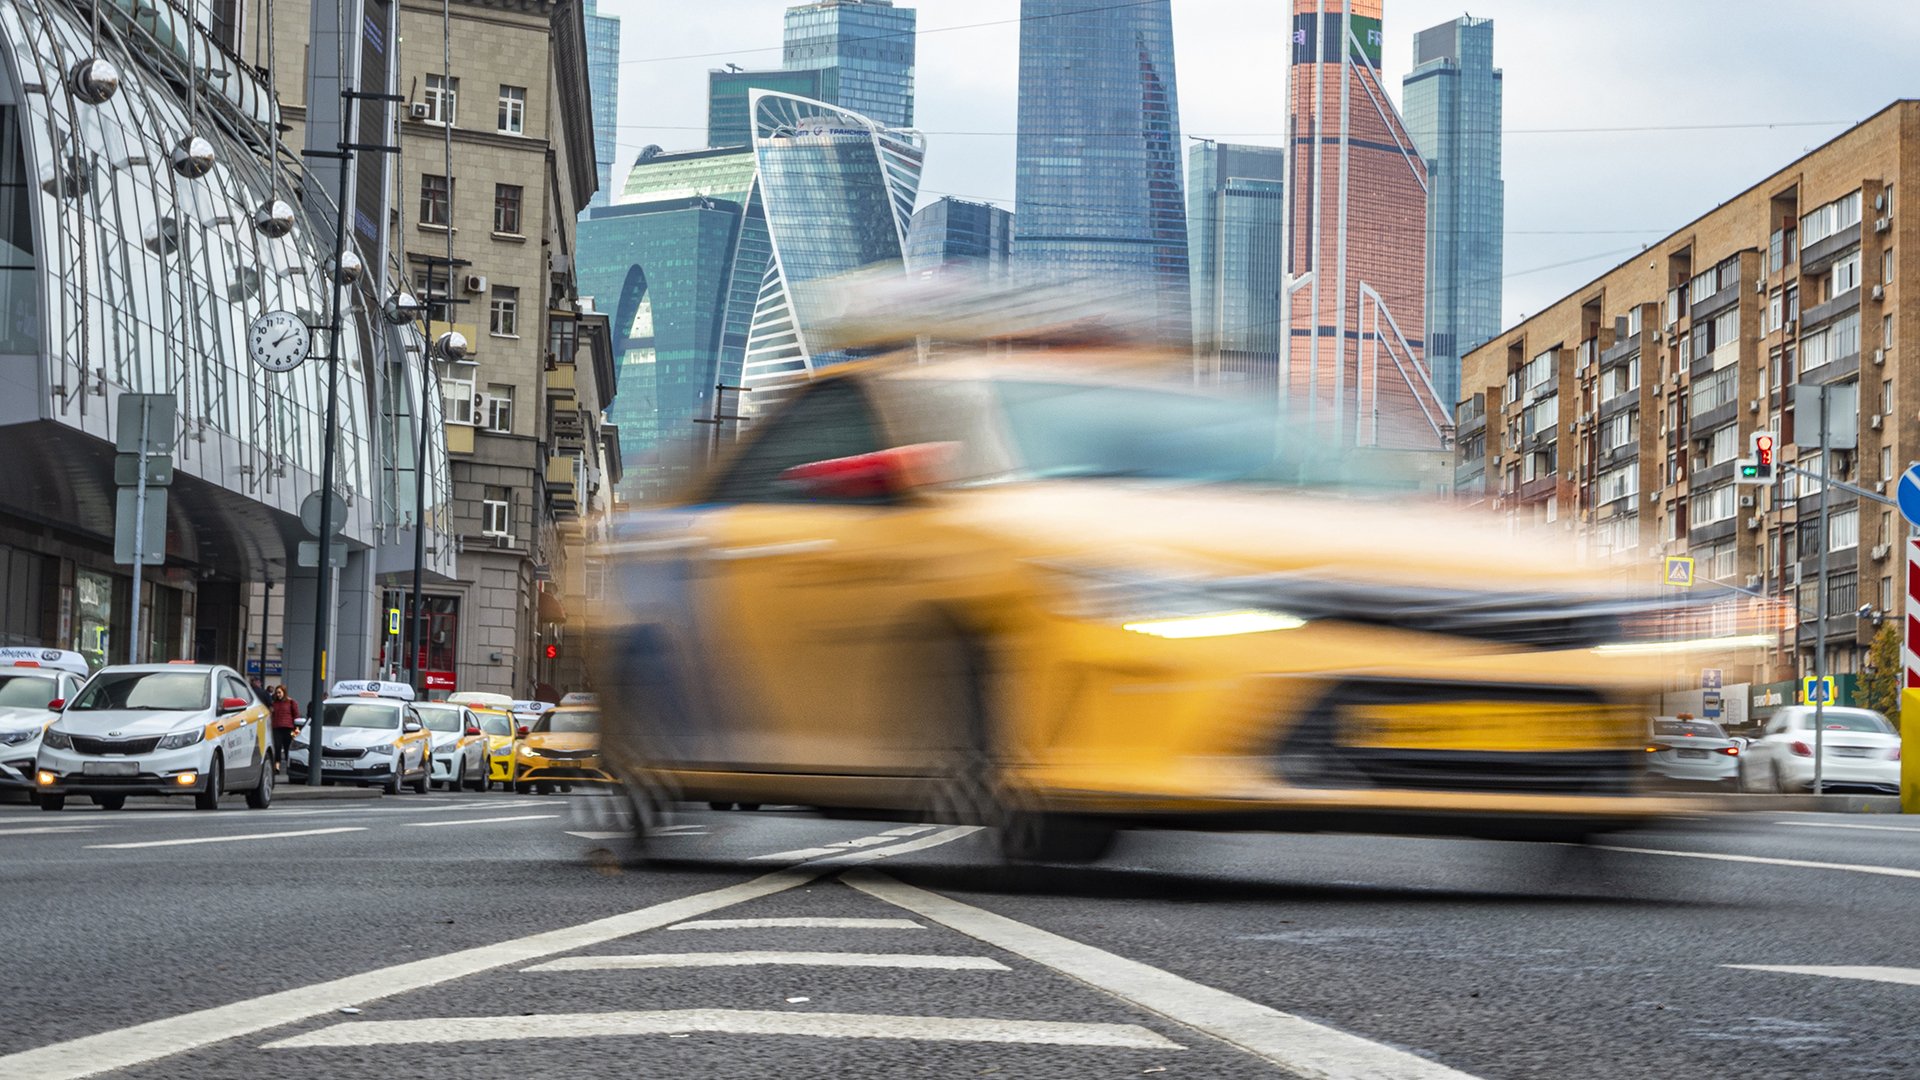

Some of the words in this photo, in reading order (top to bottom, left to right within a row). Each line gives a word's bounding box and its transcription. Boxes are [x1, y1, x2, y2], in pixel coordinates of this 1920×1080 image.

[829, 128, 871, 136] ТРАНСНЕФ
[276, 317, 284, 325] 12
[339, 683, 363, 691] Яндекс
